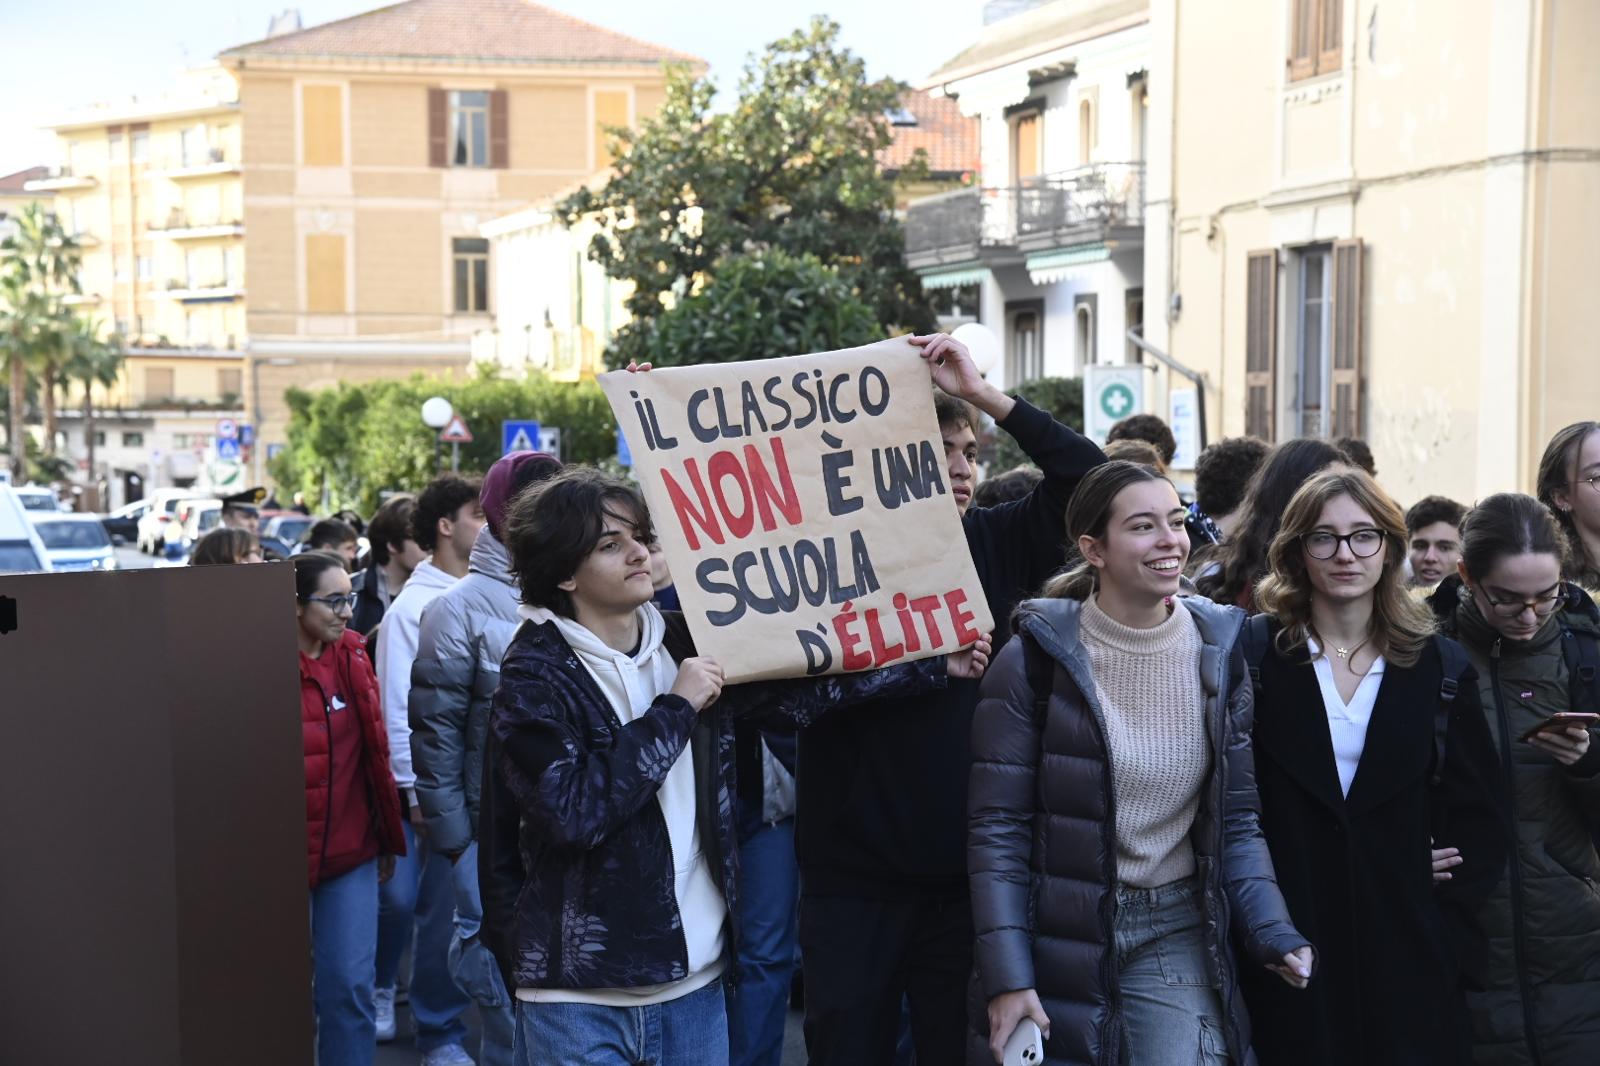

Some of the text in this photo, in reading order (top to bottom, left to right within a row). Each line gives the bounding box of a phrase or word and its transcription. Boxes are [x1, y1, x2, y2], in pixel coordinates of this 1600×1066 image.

[660, 430, 946, 550] NON È UNA
[696, 529, 880, 627] SCUOLA
